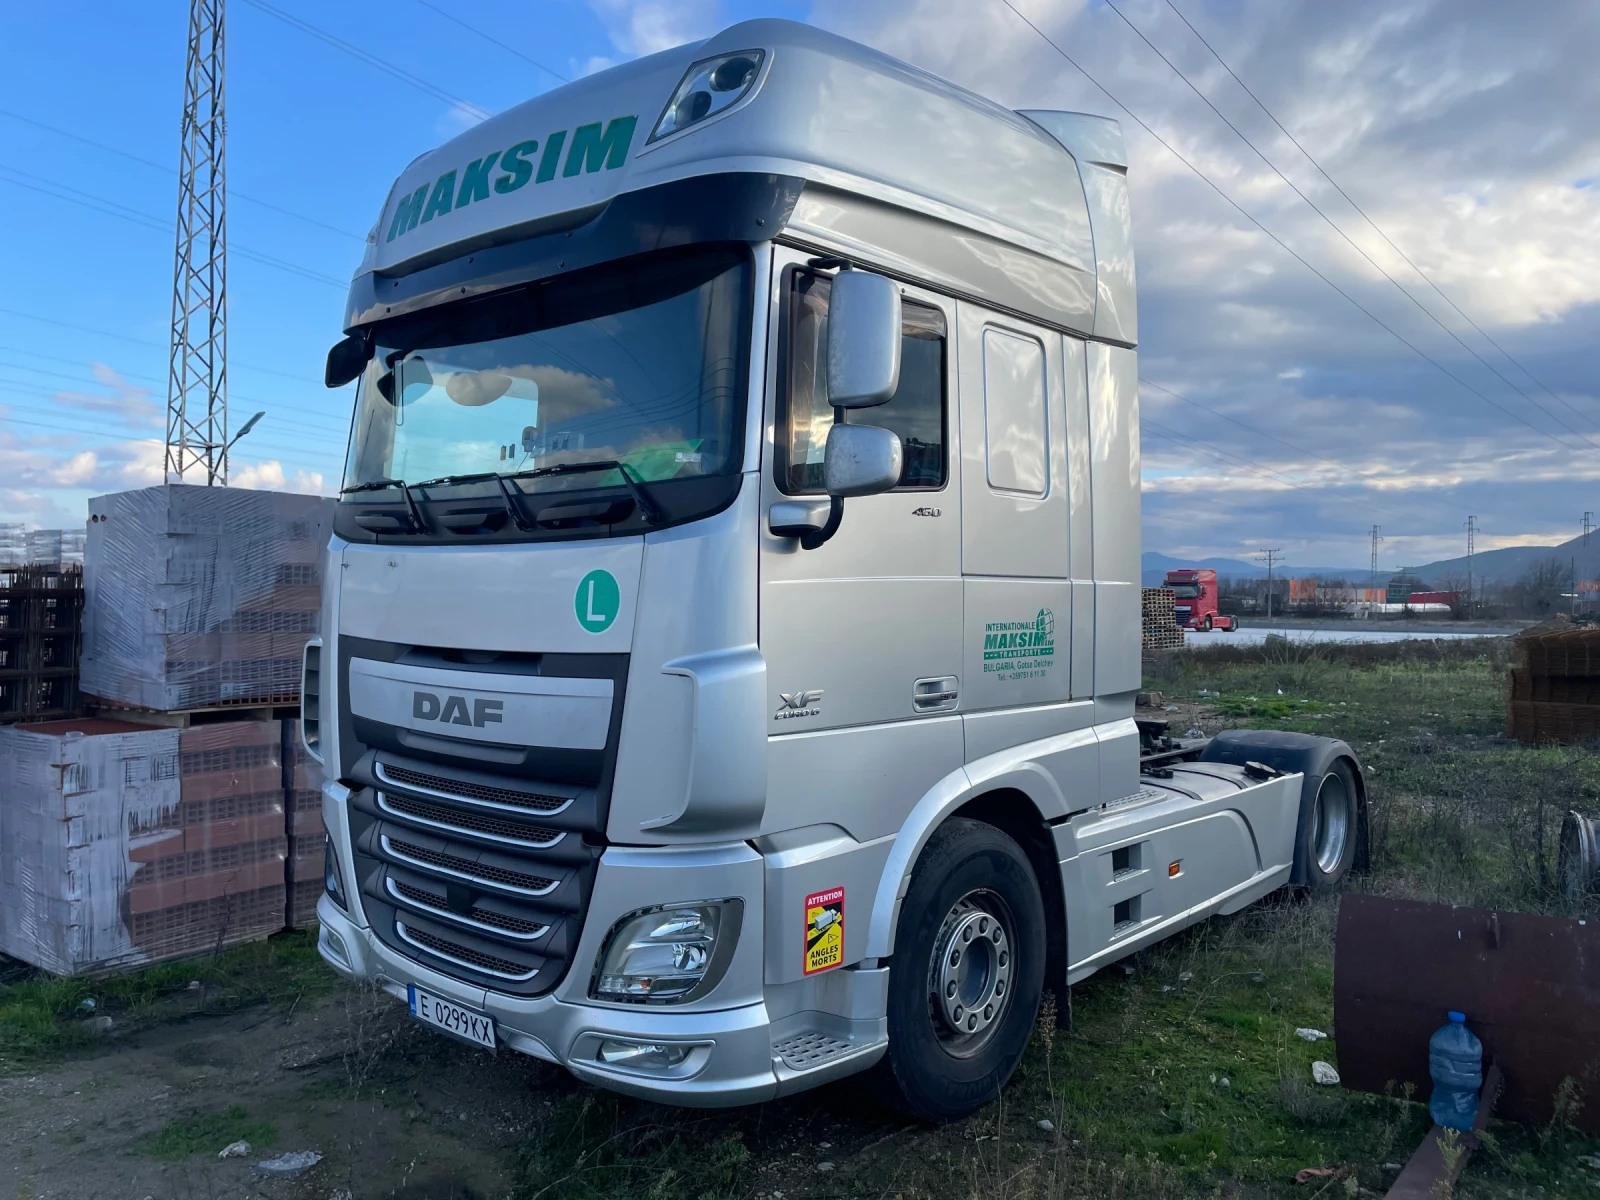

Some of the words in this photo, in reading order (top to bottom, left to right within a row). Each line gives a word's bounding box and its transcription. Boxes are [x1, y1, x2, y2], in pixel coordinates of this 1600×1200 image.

[386, 114, 639, 243] MAKSIM
[586, 580, 606, 622] L
[985, 622, 1036, 632] INTERNATIONALE
[984, 632, 1046, 650] MAKSIM
[1000, 650, 1041, 658] TRANSPORTE
[1017, 660, 1033, 670] Gotse
[1034, 659, 1054, 668] Delchev
[775, 689, 825, 711] XF
[412, 690, 504, 728] DAF
[807, 890, 843, 906] ATTENTION
[810, 944, 839, 960] ANGLES
[811, 953, 837, 968] MORTS
[420, 994, 430, 1018] E
